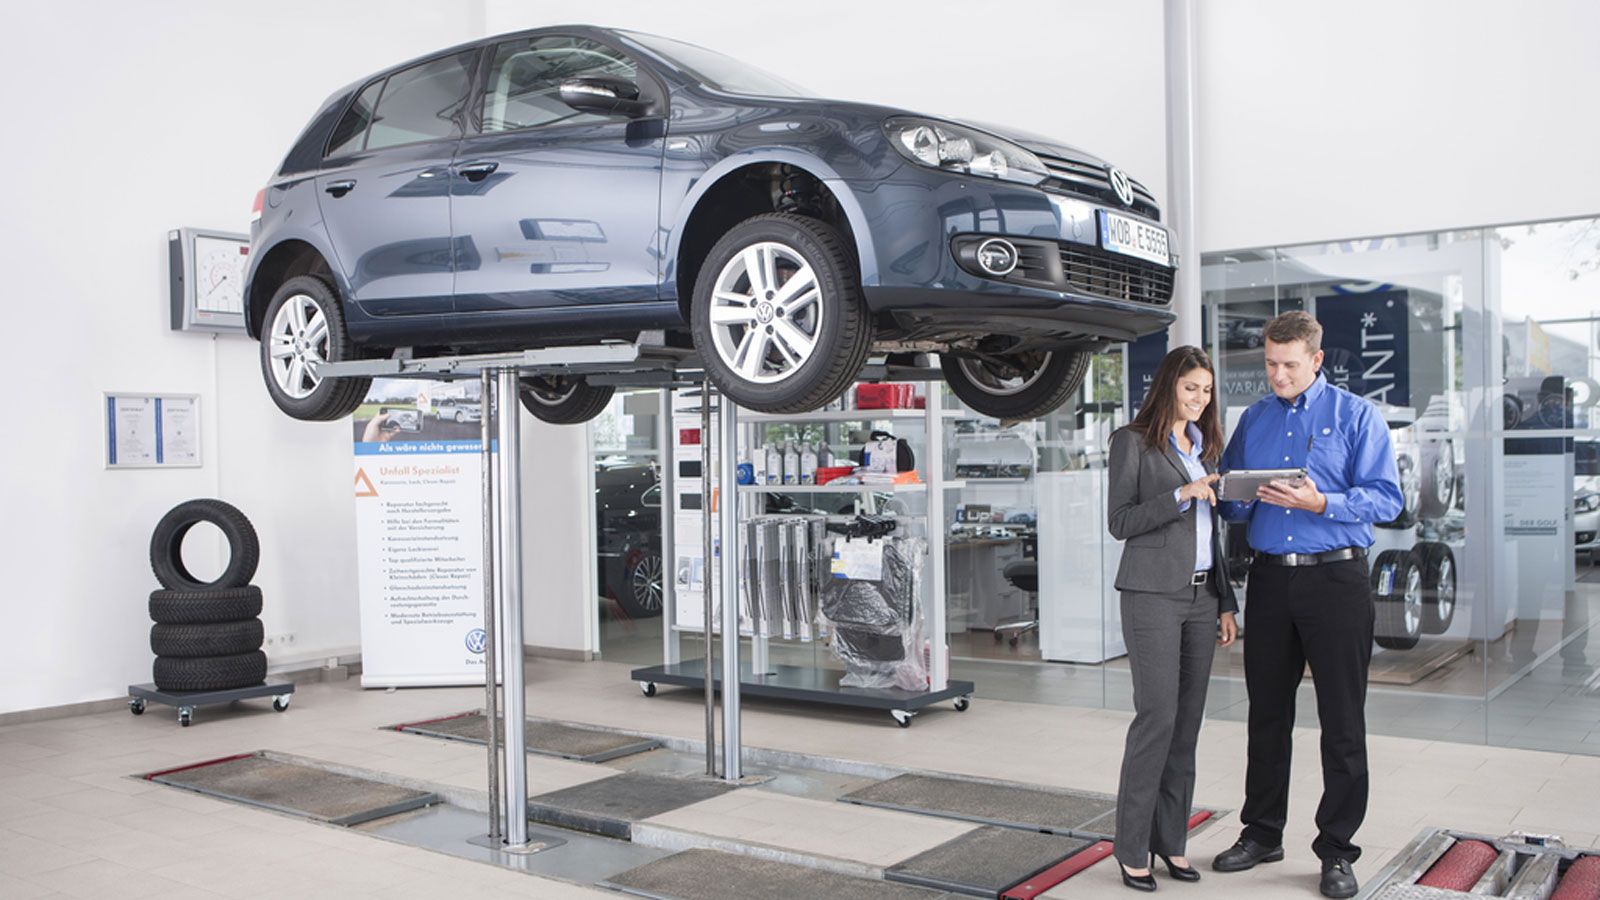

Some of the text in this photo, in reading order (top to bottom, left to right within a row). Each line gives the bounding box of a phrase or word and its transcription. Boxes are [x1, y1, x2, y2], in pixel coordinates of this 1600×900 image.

[1109, 216, 1130, 245] WOB
[1225, 381, 1271, 394] VARIA
[378, 443, 393, 452] Als
[395, 443, 417, 452] wäre
[419, 442, 444, 451] nichts
[380, 465, 460, 476] Unfall Spezialist
